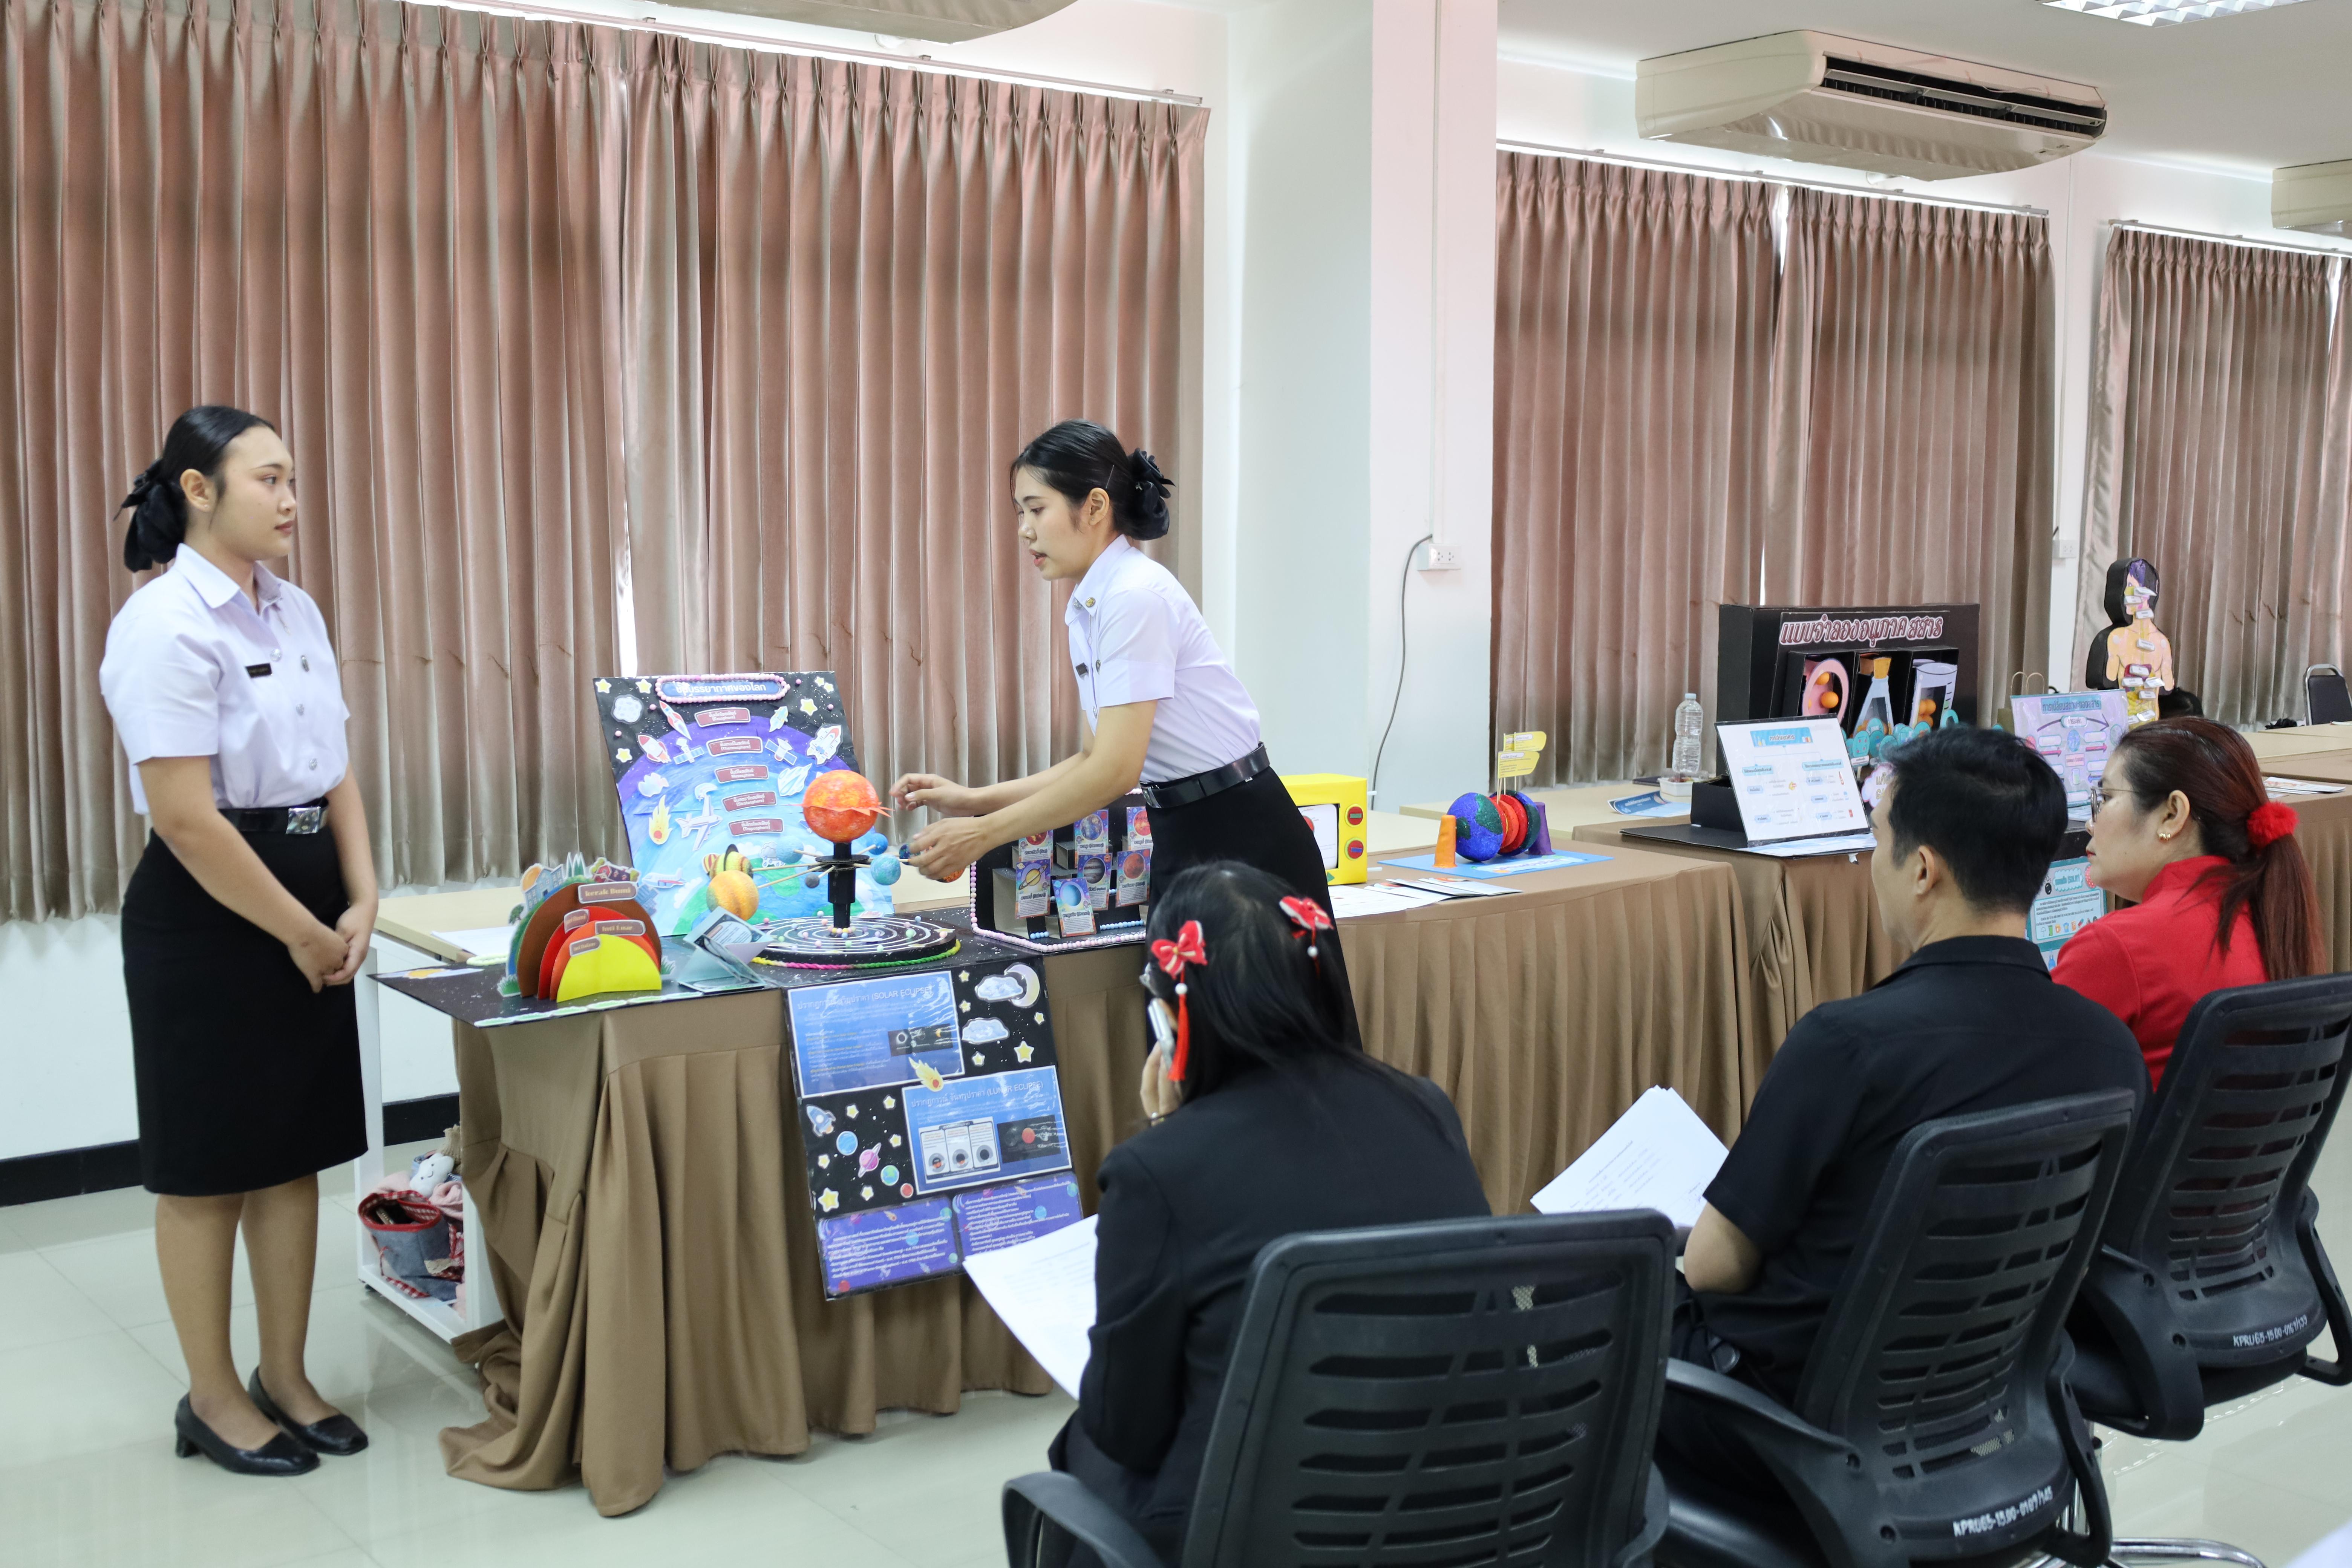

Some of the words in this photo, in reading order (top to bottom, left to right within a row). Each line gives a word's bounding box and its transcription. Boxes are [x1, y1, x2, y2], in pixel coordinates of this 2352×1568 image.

[676, 681, 767, 694] ชบรรยากาศของโลก
[872, 990, 899, 1001] (SOLAR
[1014, 1081, 1044, 1091] ECLIPSE)
